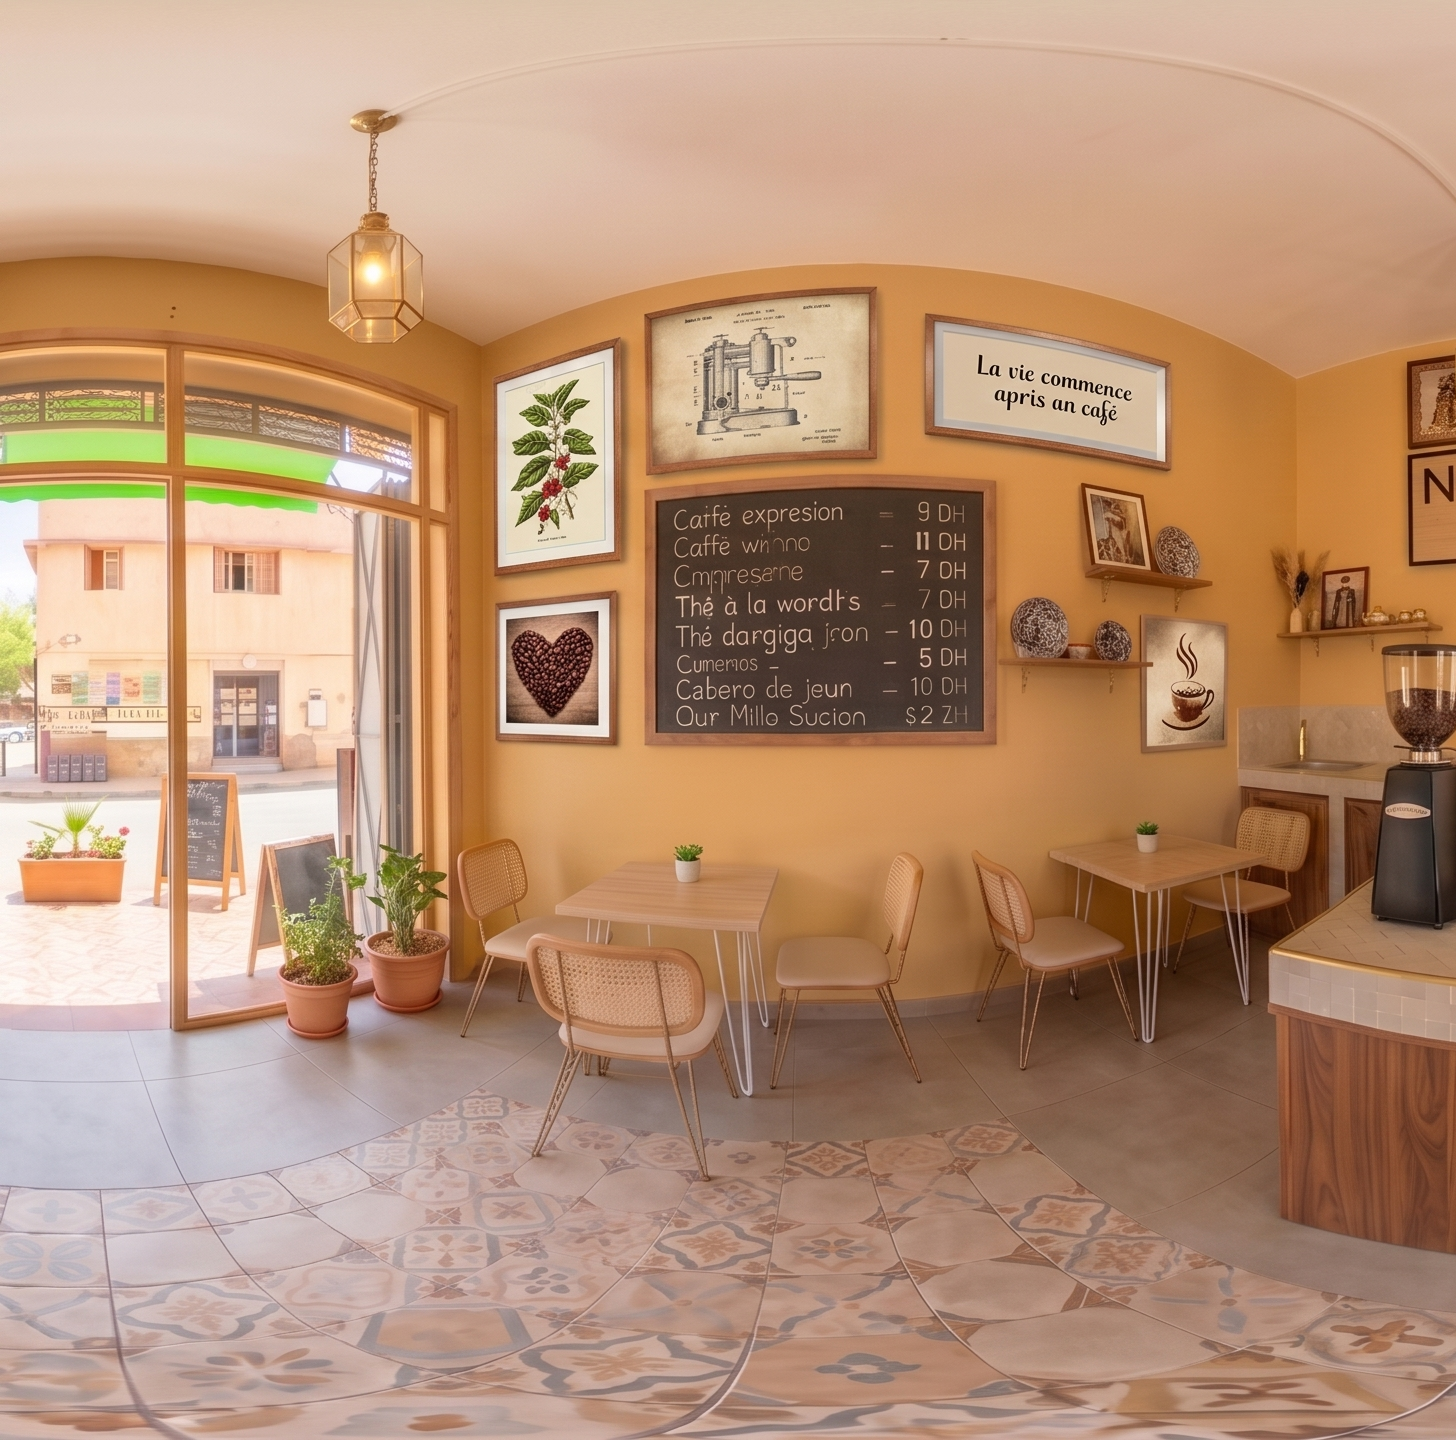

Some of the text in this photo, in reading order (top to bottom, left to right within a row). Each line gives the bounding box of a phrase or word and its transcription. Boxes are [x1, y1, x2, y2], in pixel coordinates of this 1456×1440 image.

[977, 354, 1133, 402] La vie commence
[994, 388, 1118, 426] apris an café
[742, 501, 844, 532] expresion
[917, 501, 930, 522] 9
[938, 503, 965, 524] DH
[916, 531, 930, 551] 11
[938, 532, 966, 552] DH
[916, 559, 930, 579] 7
[939, 561, 966, 580] DH
[724, 595, 738, 616] à
[748, 591, 767, 615] la
[918, 588, 931, 610] 7
[939, 589, 966, 610] DH
[675, 624, 713, 648] Thé
[908, 618, 933, 640] 10
[940, 619, 967, 639] DH
[919, 647, 932, 668] 5
[940, 648, 967, 667] DH
[676, 676, 756, 700] Cabero
[765, 675, 793, 699] de
[802, 679, 853, 705] jeun
[910, 676, 933, 697] 10
[941, 676, 967, 696] DH
[676, 705, 720, 727] Our
[789, 704, 866, 727] Sucion
[941, 705, 968, 724] ZH
